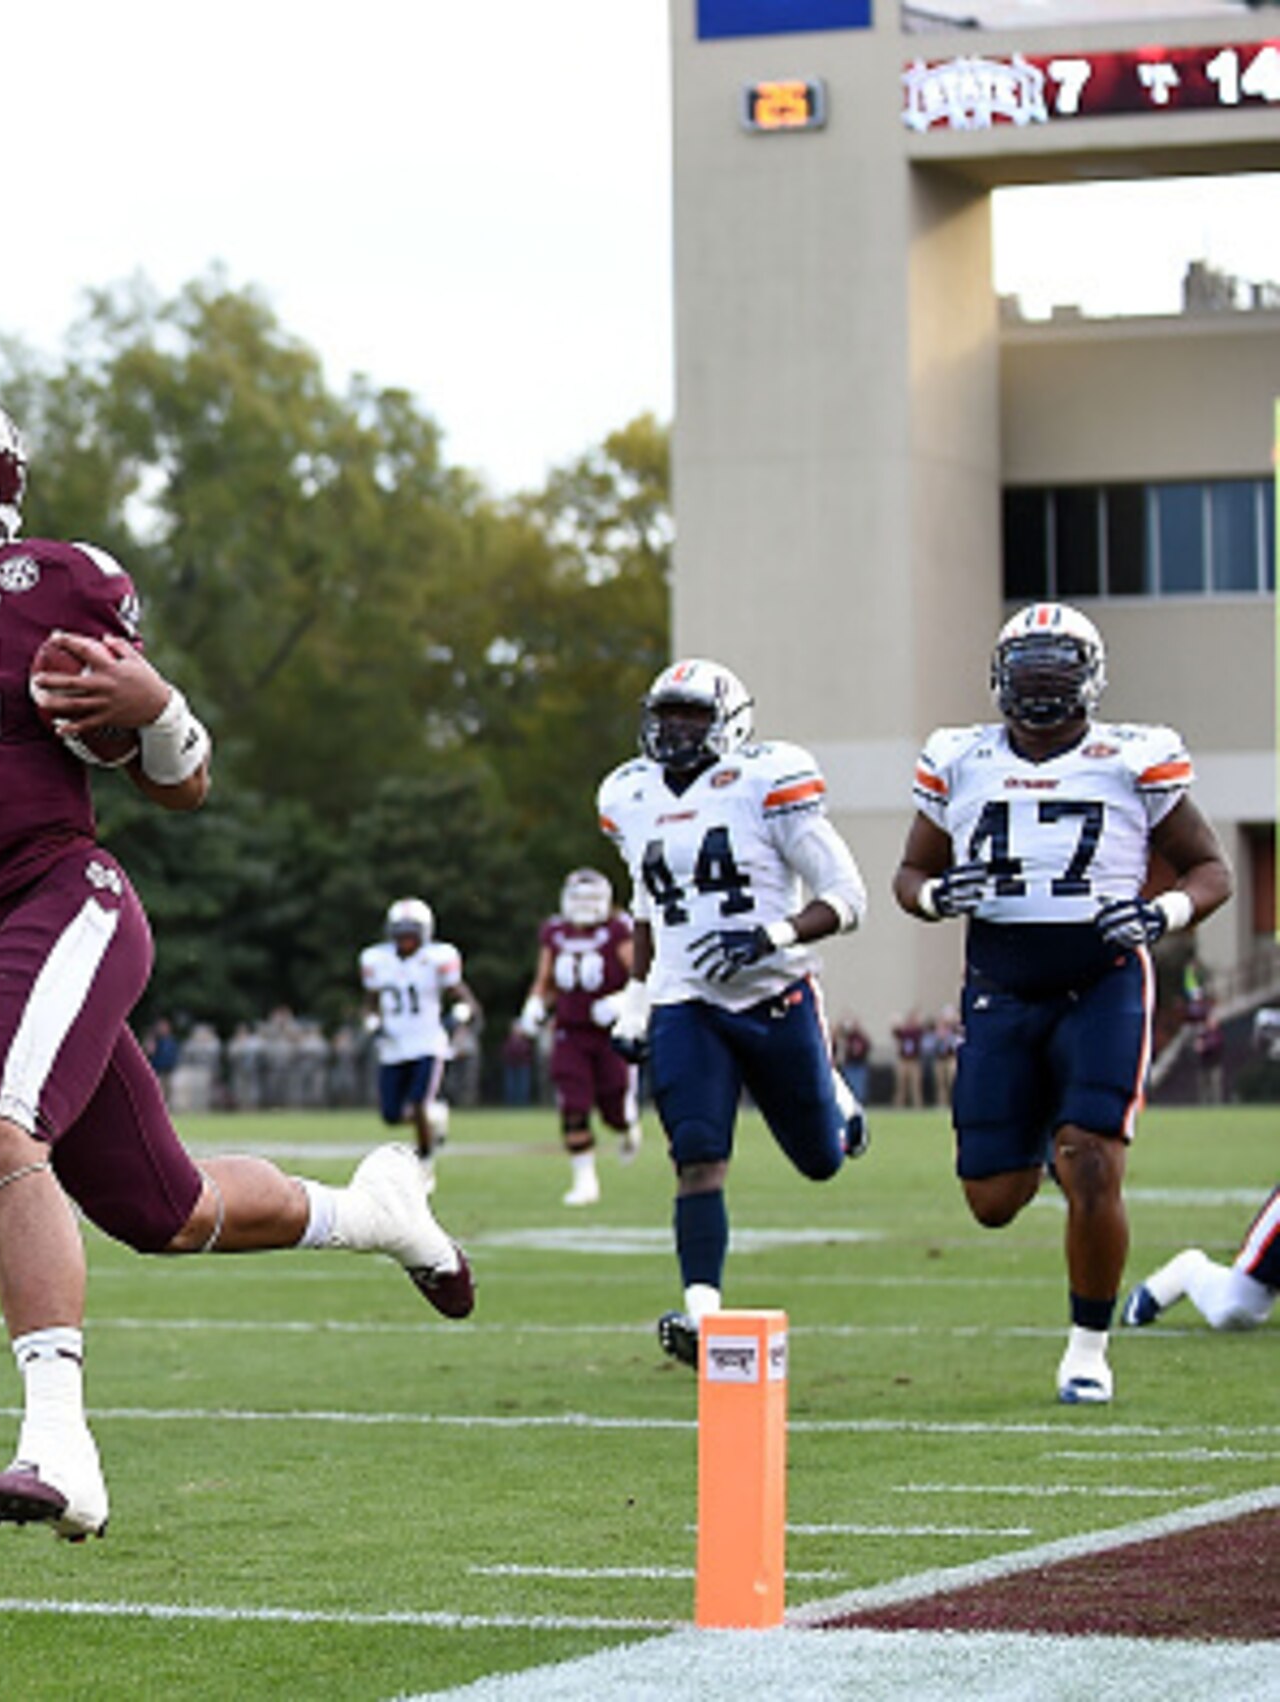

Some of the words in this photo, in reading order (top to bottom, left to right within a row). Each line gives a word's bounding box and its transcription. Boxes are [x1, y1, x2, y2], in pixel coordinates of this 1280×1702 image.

[1046, 59, 1091, 114] 7
[1205, 47, 1280, 104] 14
[642, 825, 756, 928] 44
[968, 800, 1105, 897] 47
